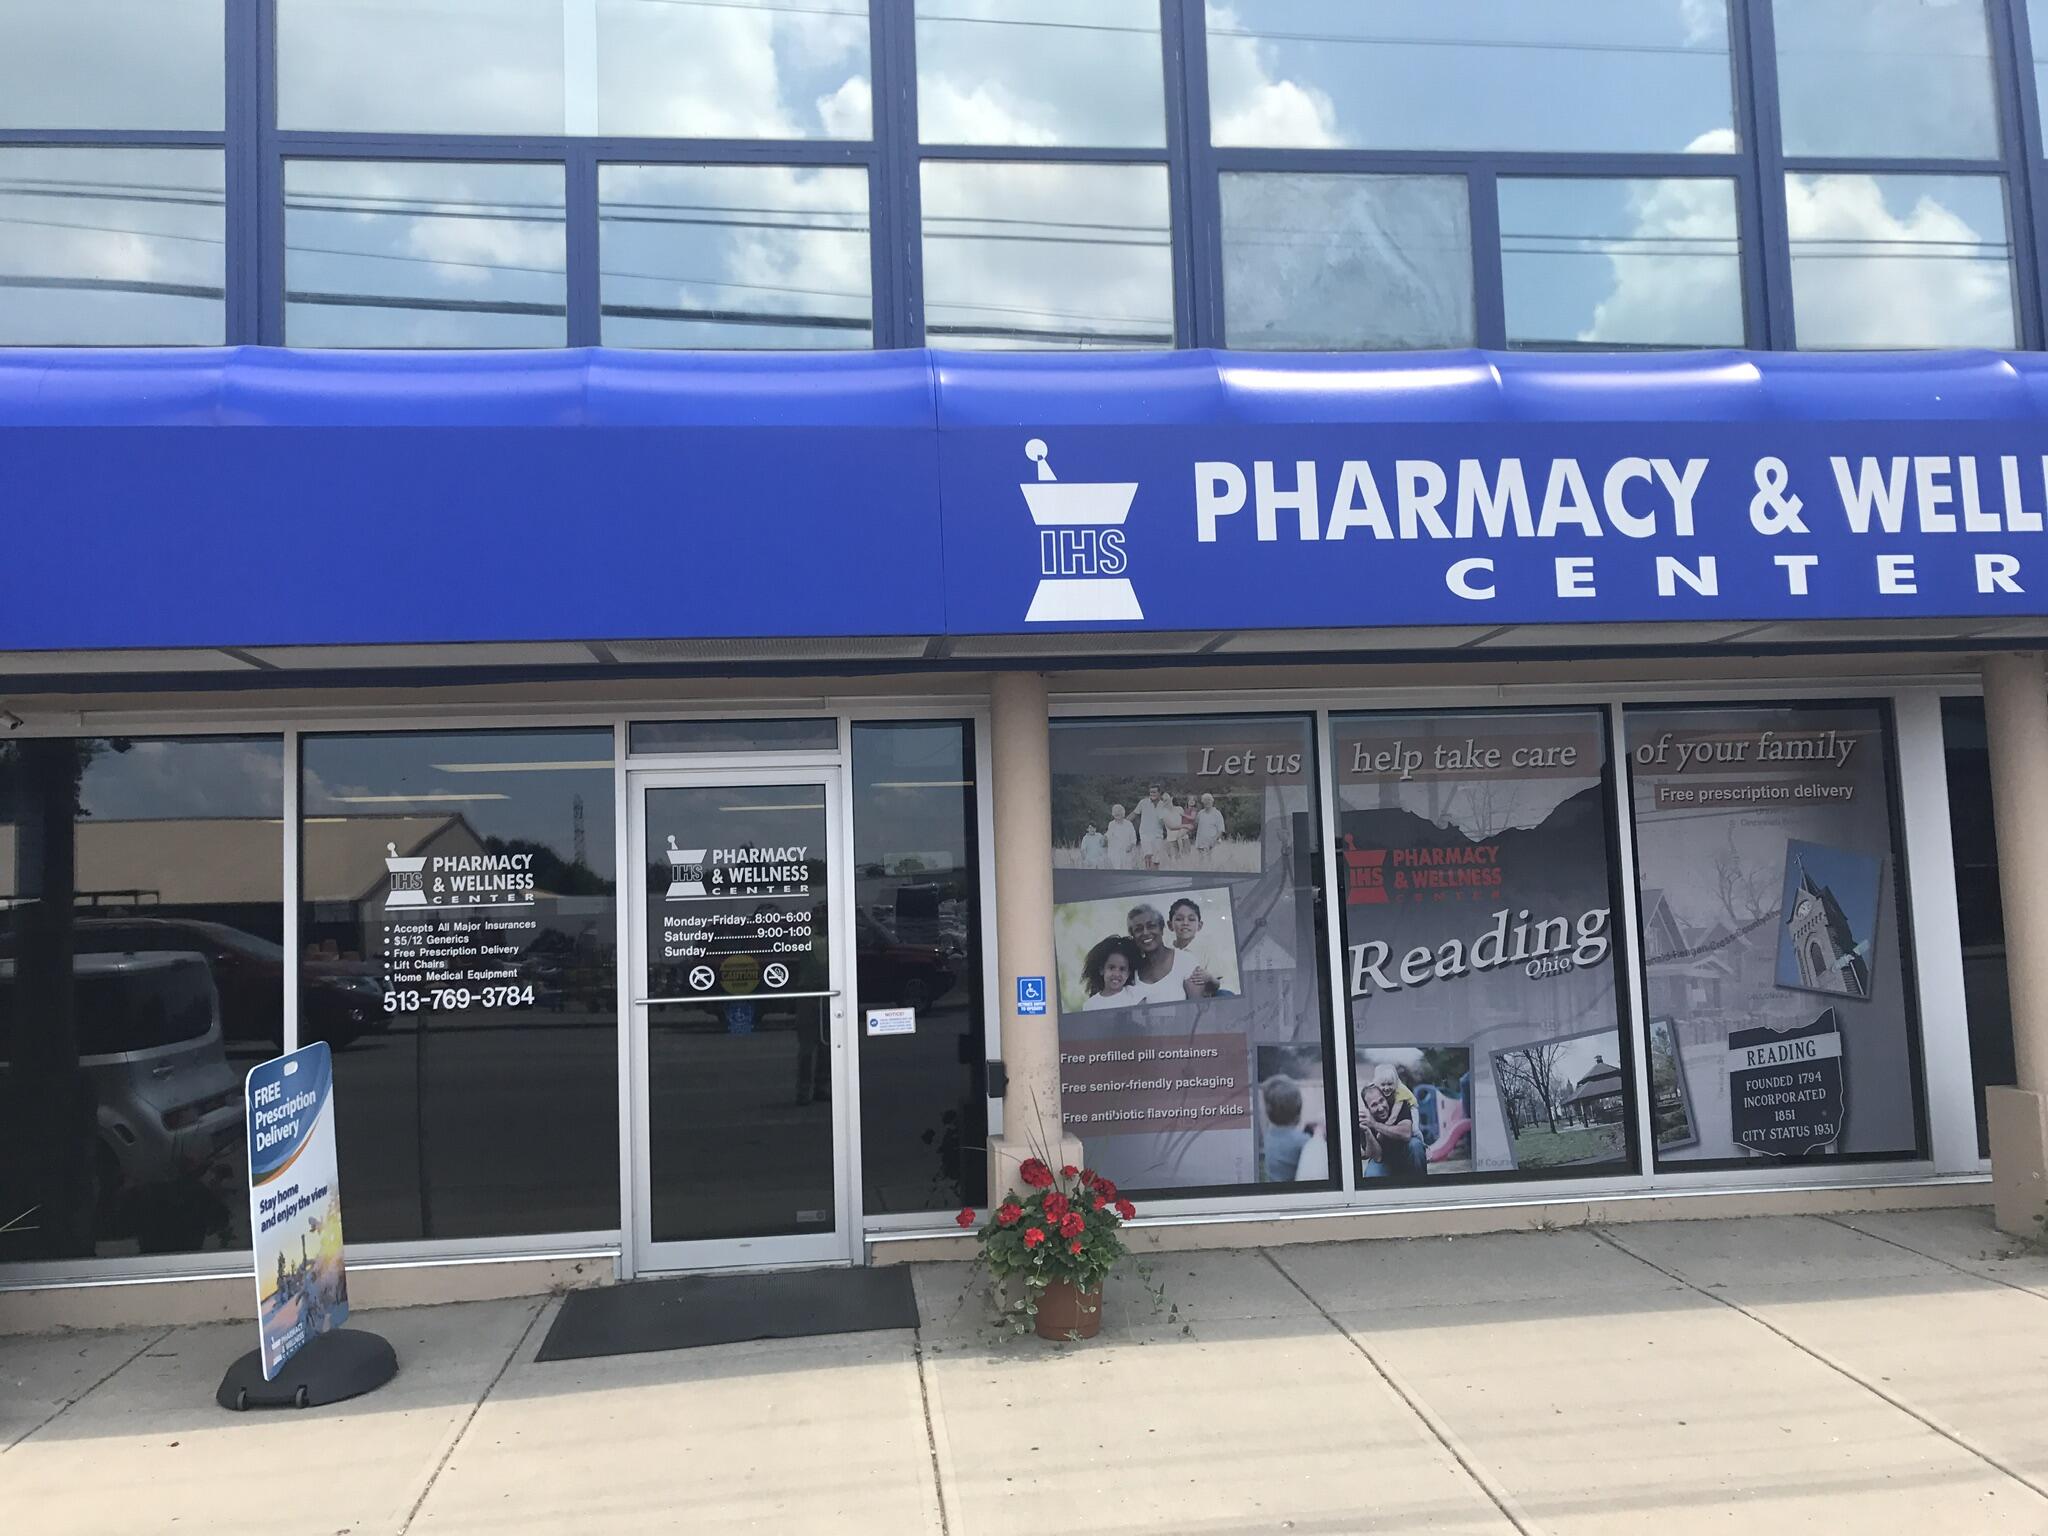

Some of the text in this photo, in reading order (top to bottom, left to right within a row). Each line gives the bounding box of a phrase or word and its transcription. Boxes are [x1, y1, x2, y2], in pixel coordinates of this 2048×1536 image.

[1194, 455, 2048, 542] PHARMACY & WELL
[1040, 529, 1128, 575] IHS
[1445, 553, 2025, 601] CENTER
[1197, 747, 1301, 775] Let us
[1351, 740, 1577, 780] help take care
[1636, 730, 1856, 772] of your family
[1661, 784, 1854, 803] Free prescription delivery
[433, 854, 534, 872] PHARMACY
[712, 847, 807, 864] PHARMACY
[1393, 846, 1499, 866] PHARMACY
[391, 873, 534, 892] IHS & WELLNESS
[672, 864, 809, 884] IHS & WELLNESS
[1394, 871, 1408, 889] &
[1412, 868, 1502, 888] WELLNESS
[433, 893, 534, 904] CENTER
[712, 885, 809, 895] CENTER
[394, 921, 536, 934] Accepts All Major Insurances
[394, 934, 469, 946] $5/12 Generics
[394, 945, 519, 958] Free Prescription Delivery
[1349, 907, 1611, 997] Reading
[394, 959, 445, 970] Lift Chairs
[1525, 956, 1570, 977] Ohio
[394, 969, 518, 982] Home Medical Equipment
[383, 985, 535, 1012] 513-769-3784
[1060, 1048, 1218, 1064] Free prefilled pill containers
[1747, 1040, 1817, 1066] READING
[1062, 1076, 1234, 1093] Free senior-friendly packaging
[1746, 1071, 1822, 1091] FOUNDED 1794
[254, 1081, 281, 1109] FREE
[1743, 1088, 1827, 1108] INCORPORATED
[255, 1090, 316, 1130] Prescription
[1063, 1104, 1243, 1123] Free antibiotic flavoring for kids
[1774, 1109, 1796, 1122] 1851
[256, 1119, 299, 1152] Delivery
[1742, 1123, 1835, 1142] CITY STATUS 1931
[260, 1182, 299, 1214] Stay home
[261, 1184, 327, 1233] and enjoy the view
